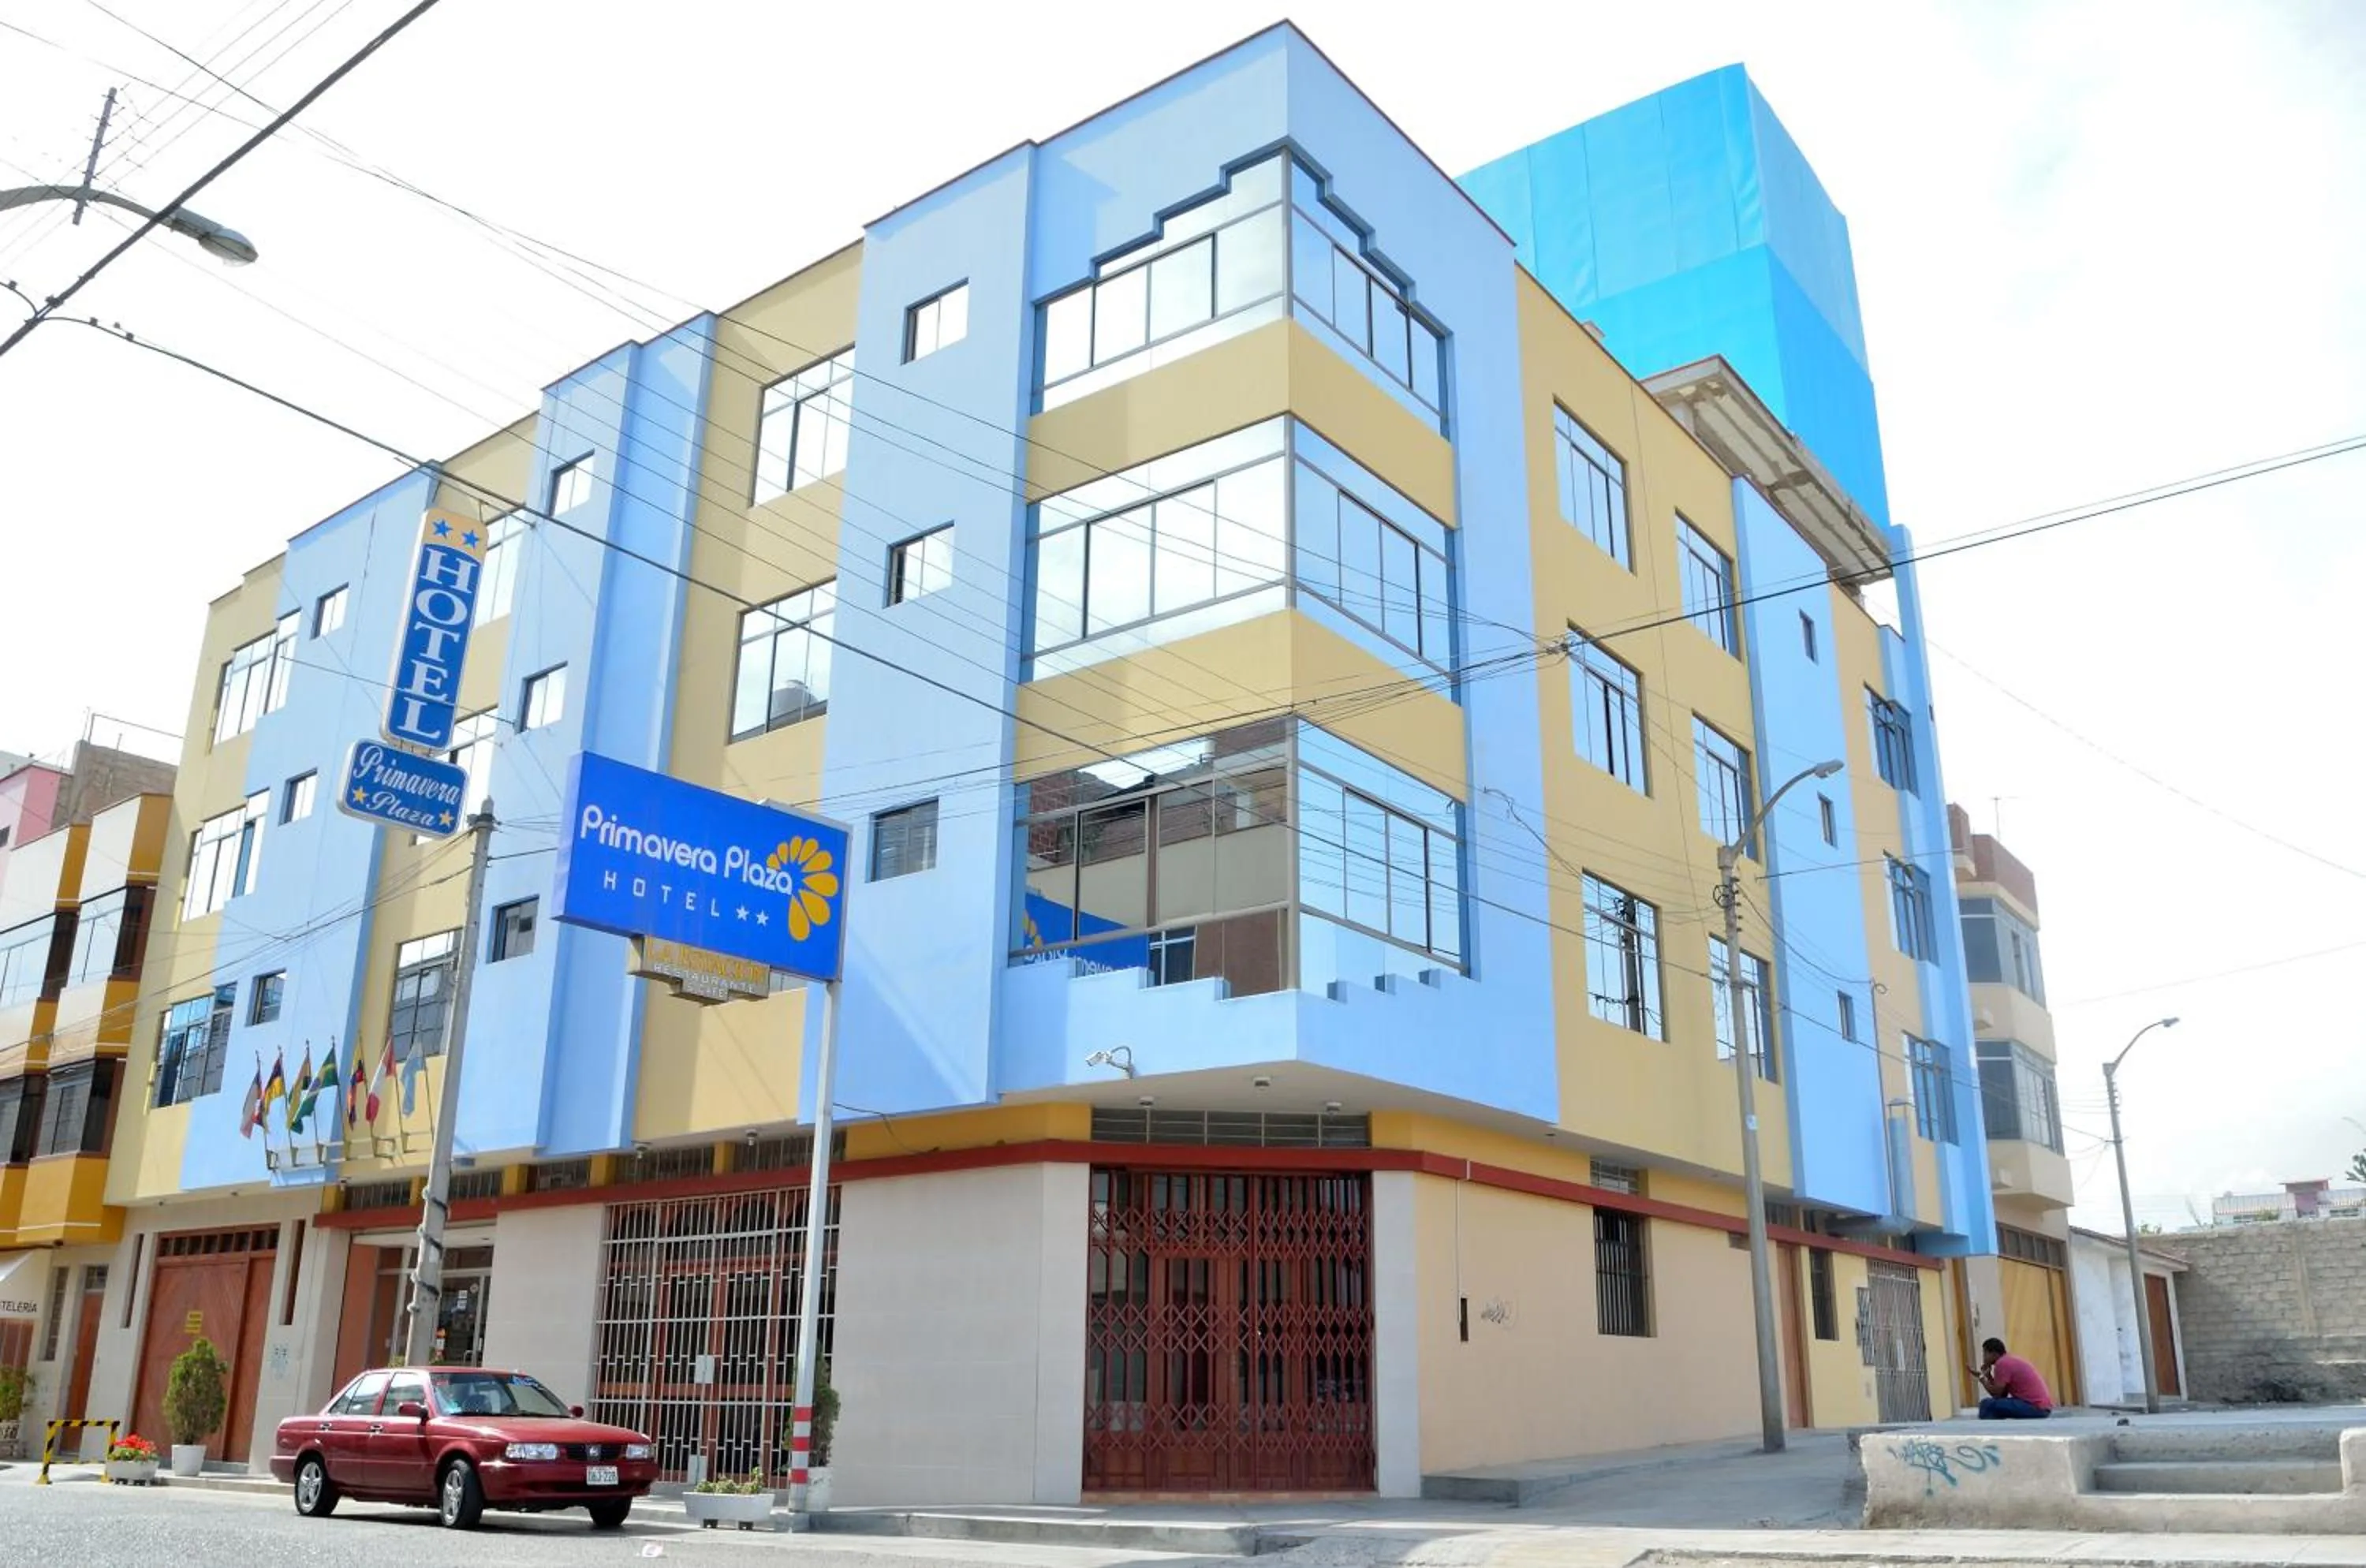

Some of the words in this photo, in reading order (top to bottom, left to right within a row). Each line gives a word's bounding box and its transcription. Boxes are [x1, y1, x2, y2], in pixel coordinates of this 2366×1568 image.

[397, 547, 478, 740] HOTEL
[353, 745, 461, 806] Primavera
[366, 790, 437, 827] Plaza
[580, 805, 717, 875] Primavera
[723, 845, 793, 895] Plaza
[603, 870, 721, 918] HOTEL
[654, 963, 753, 993] RESTAURANTE
